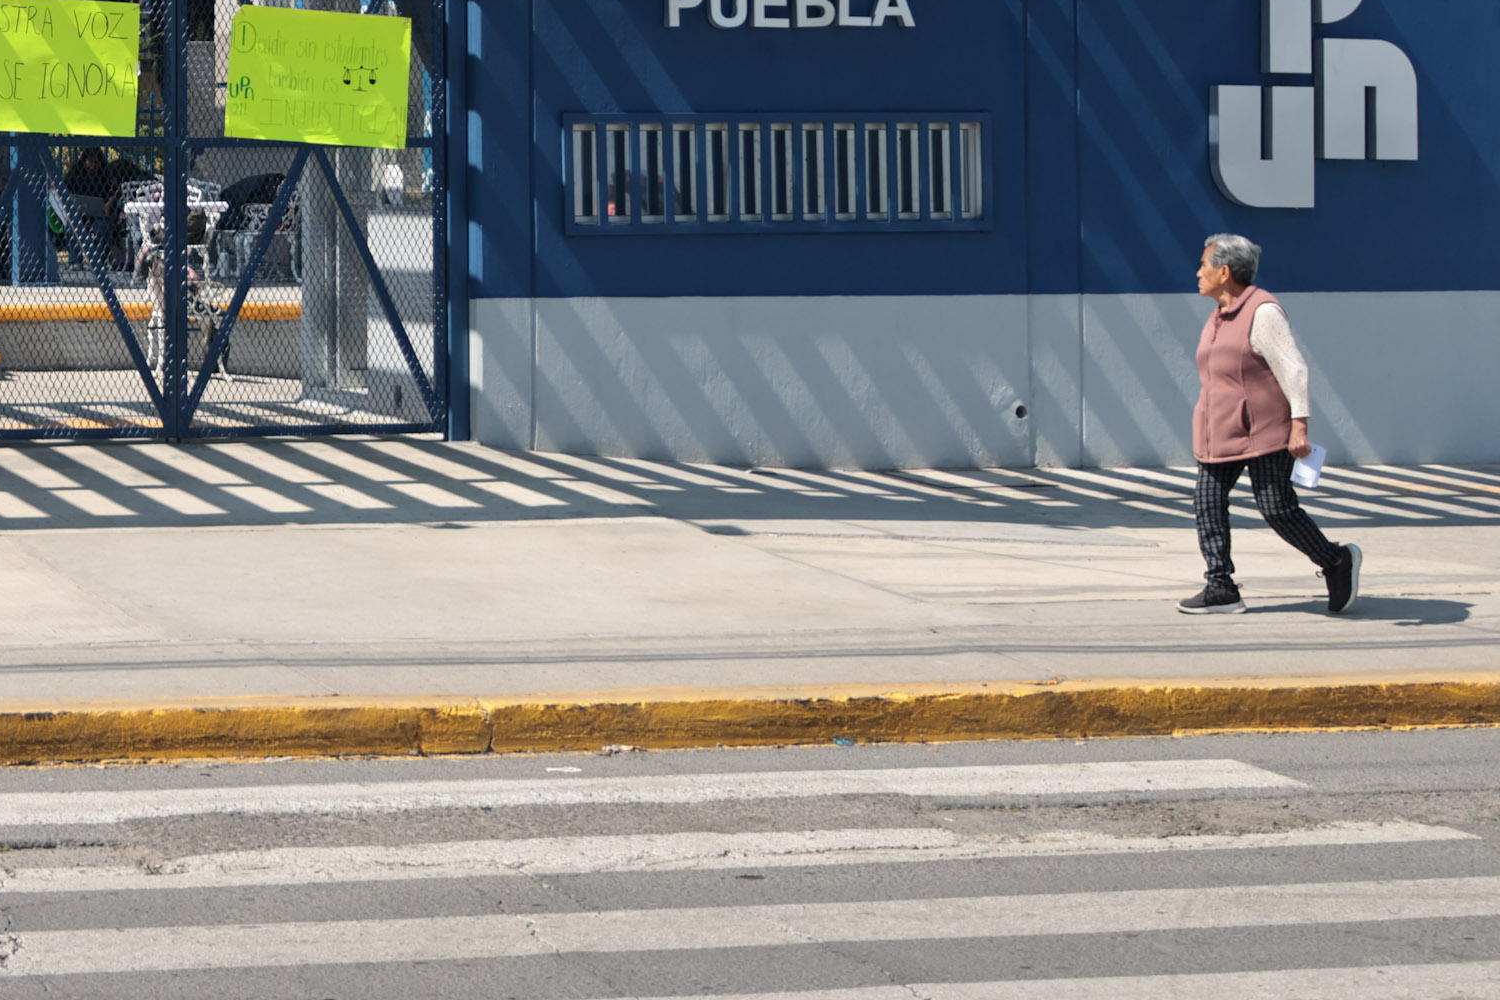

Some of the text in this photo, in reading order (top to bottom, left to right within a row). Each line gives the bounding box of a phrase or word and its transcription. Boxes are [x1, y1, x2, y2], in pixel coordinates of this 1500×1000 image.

[73, 9, 129, 40] VOZ
[296, 37, 316, 61] sin
[324, 35, 389, 67] estudiantes
[37, 62, 136, 100] IGNORA
